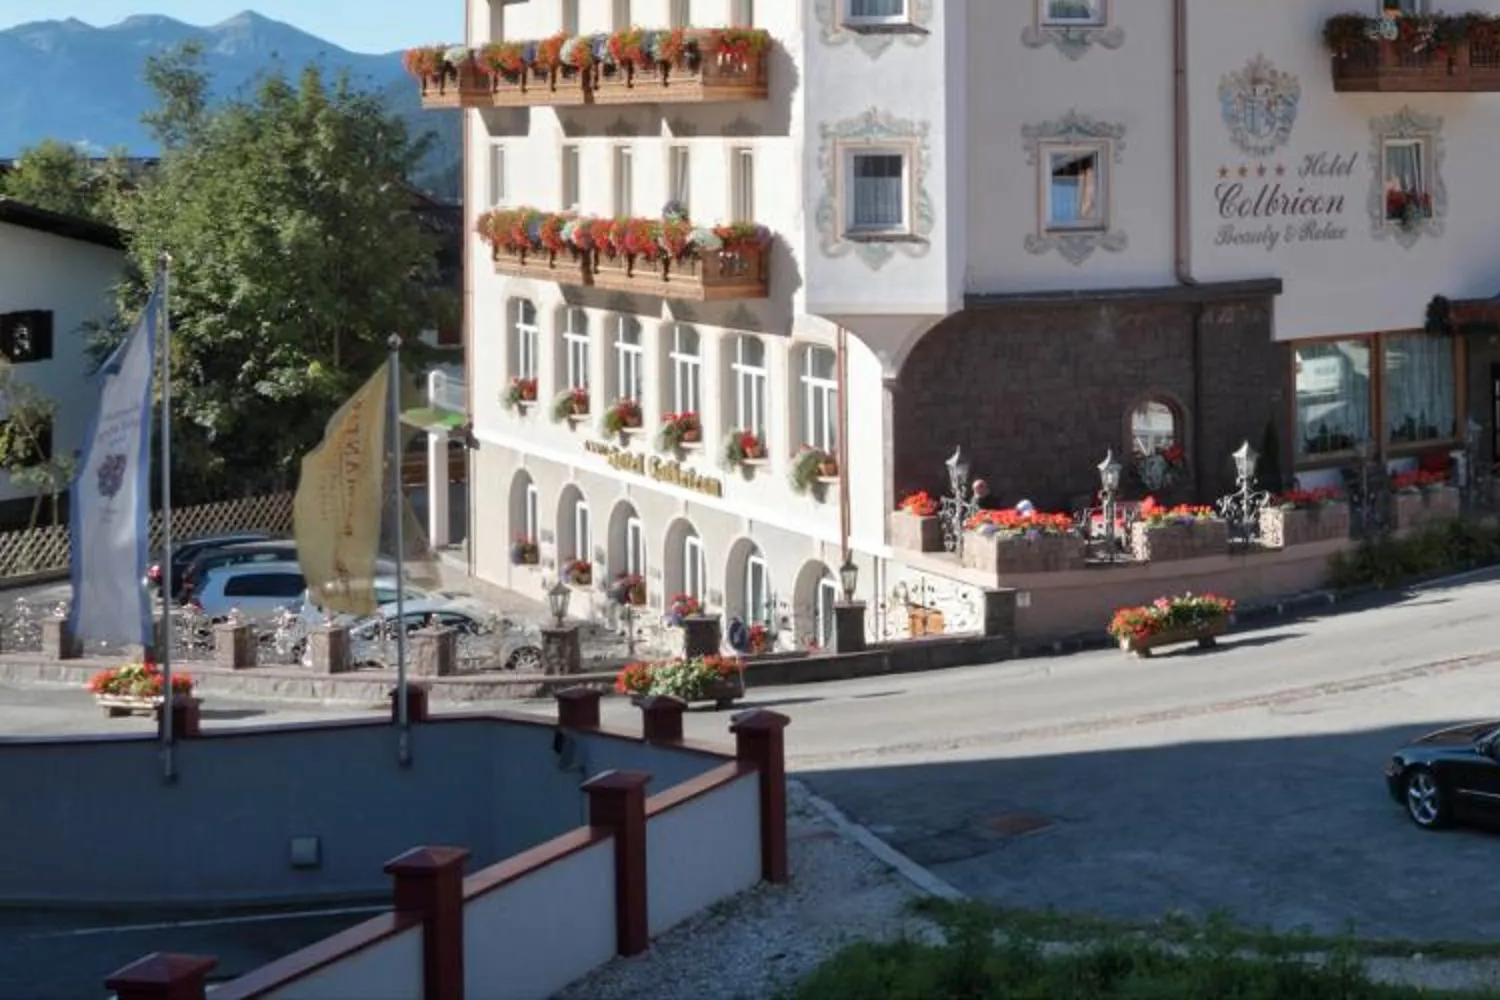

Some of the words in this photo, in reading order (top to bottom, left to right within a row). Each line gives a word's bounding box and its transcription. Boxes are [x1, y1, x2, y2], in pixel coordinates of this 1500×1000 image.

[1297, 151, 1358, 178] Hotel
[1214, 182, 1345, 219] Colbricon
[1213, 223, 1280, 252] Beauty
[1298, 219, 1348, 242] Relax
